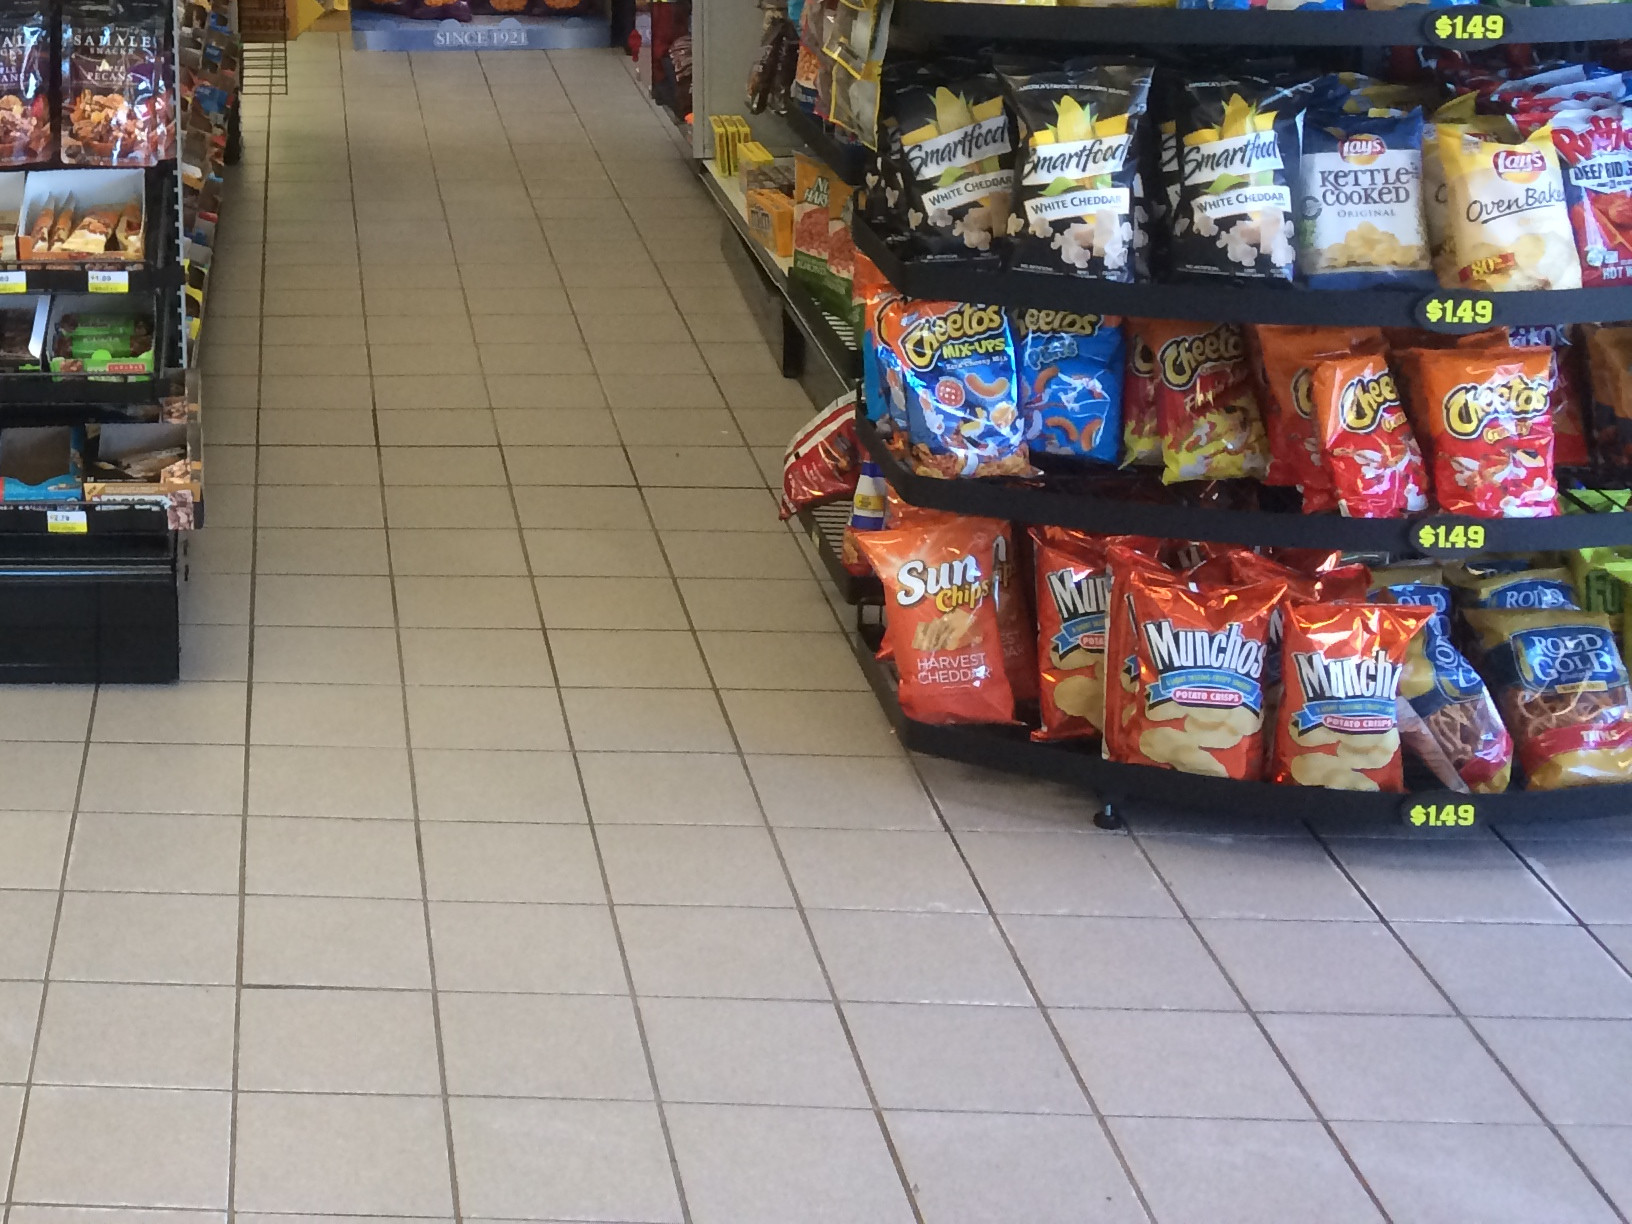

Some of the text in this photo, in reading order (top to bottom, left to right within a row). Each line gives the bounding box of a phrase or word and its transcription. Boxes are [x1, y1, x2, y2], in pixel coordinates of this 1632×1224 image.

[435, 31, 528, 46] SINCE 1921
[1434, 15, 1504, 40] $1.49
[905, 124, 1009, 170] Smartfood
[1023, 138, 1128, 178] Smartfood
[1183, 133, 1281, 172] Smartfood
[928, 186, 963, 208] WHITE
[1031, 194, 1122, 216] WHITE CHEDDAR
[1197, 196, 1237, 215] WHITE
[1525, 181, 1568, 206] Bake
[1425, 299, 1493, 324] $1.49
[901, 302, 1003, 373] Cheetos
[942, 336, 1006, 360] MIX-UPS
[1444, 374, 1549, 438] Cheetos
[1418, 524, 1486, 549] $1.49
[897, 554, 980, 607] Sun
[935, 580, 990, 613] Chips
[1143, 618, 1267, 678] Munchos
[1531, 633, 1604, 657] ROLD
[916, 652, 988, 671] HARVEST
[1294, 646, 1403, 701] Munch
[1532, 649, 1614, 681] GOLD
[1175, 690, 1208, 702] POTATO
[1326, 717, 1360, 728] POTATO
[1409, 804, 1476, 827] $1.49
